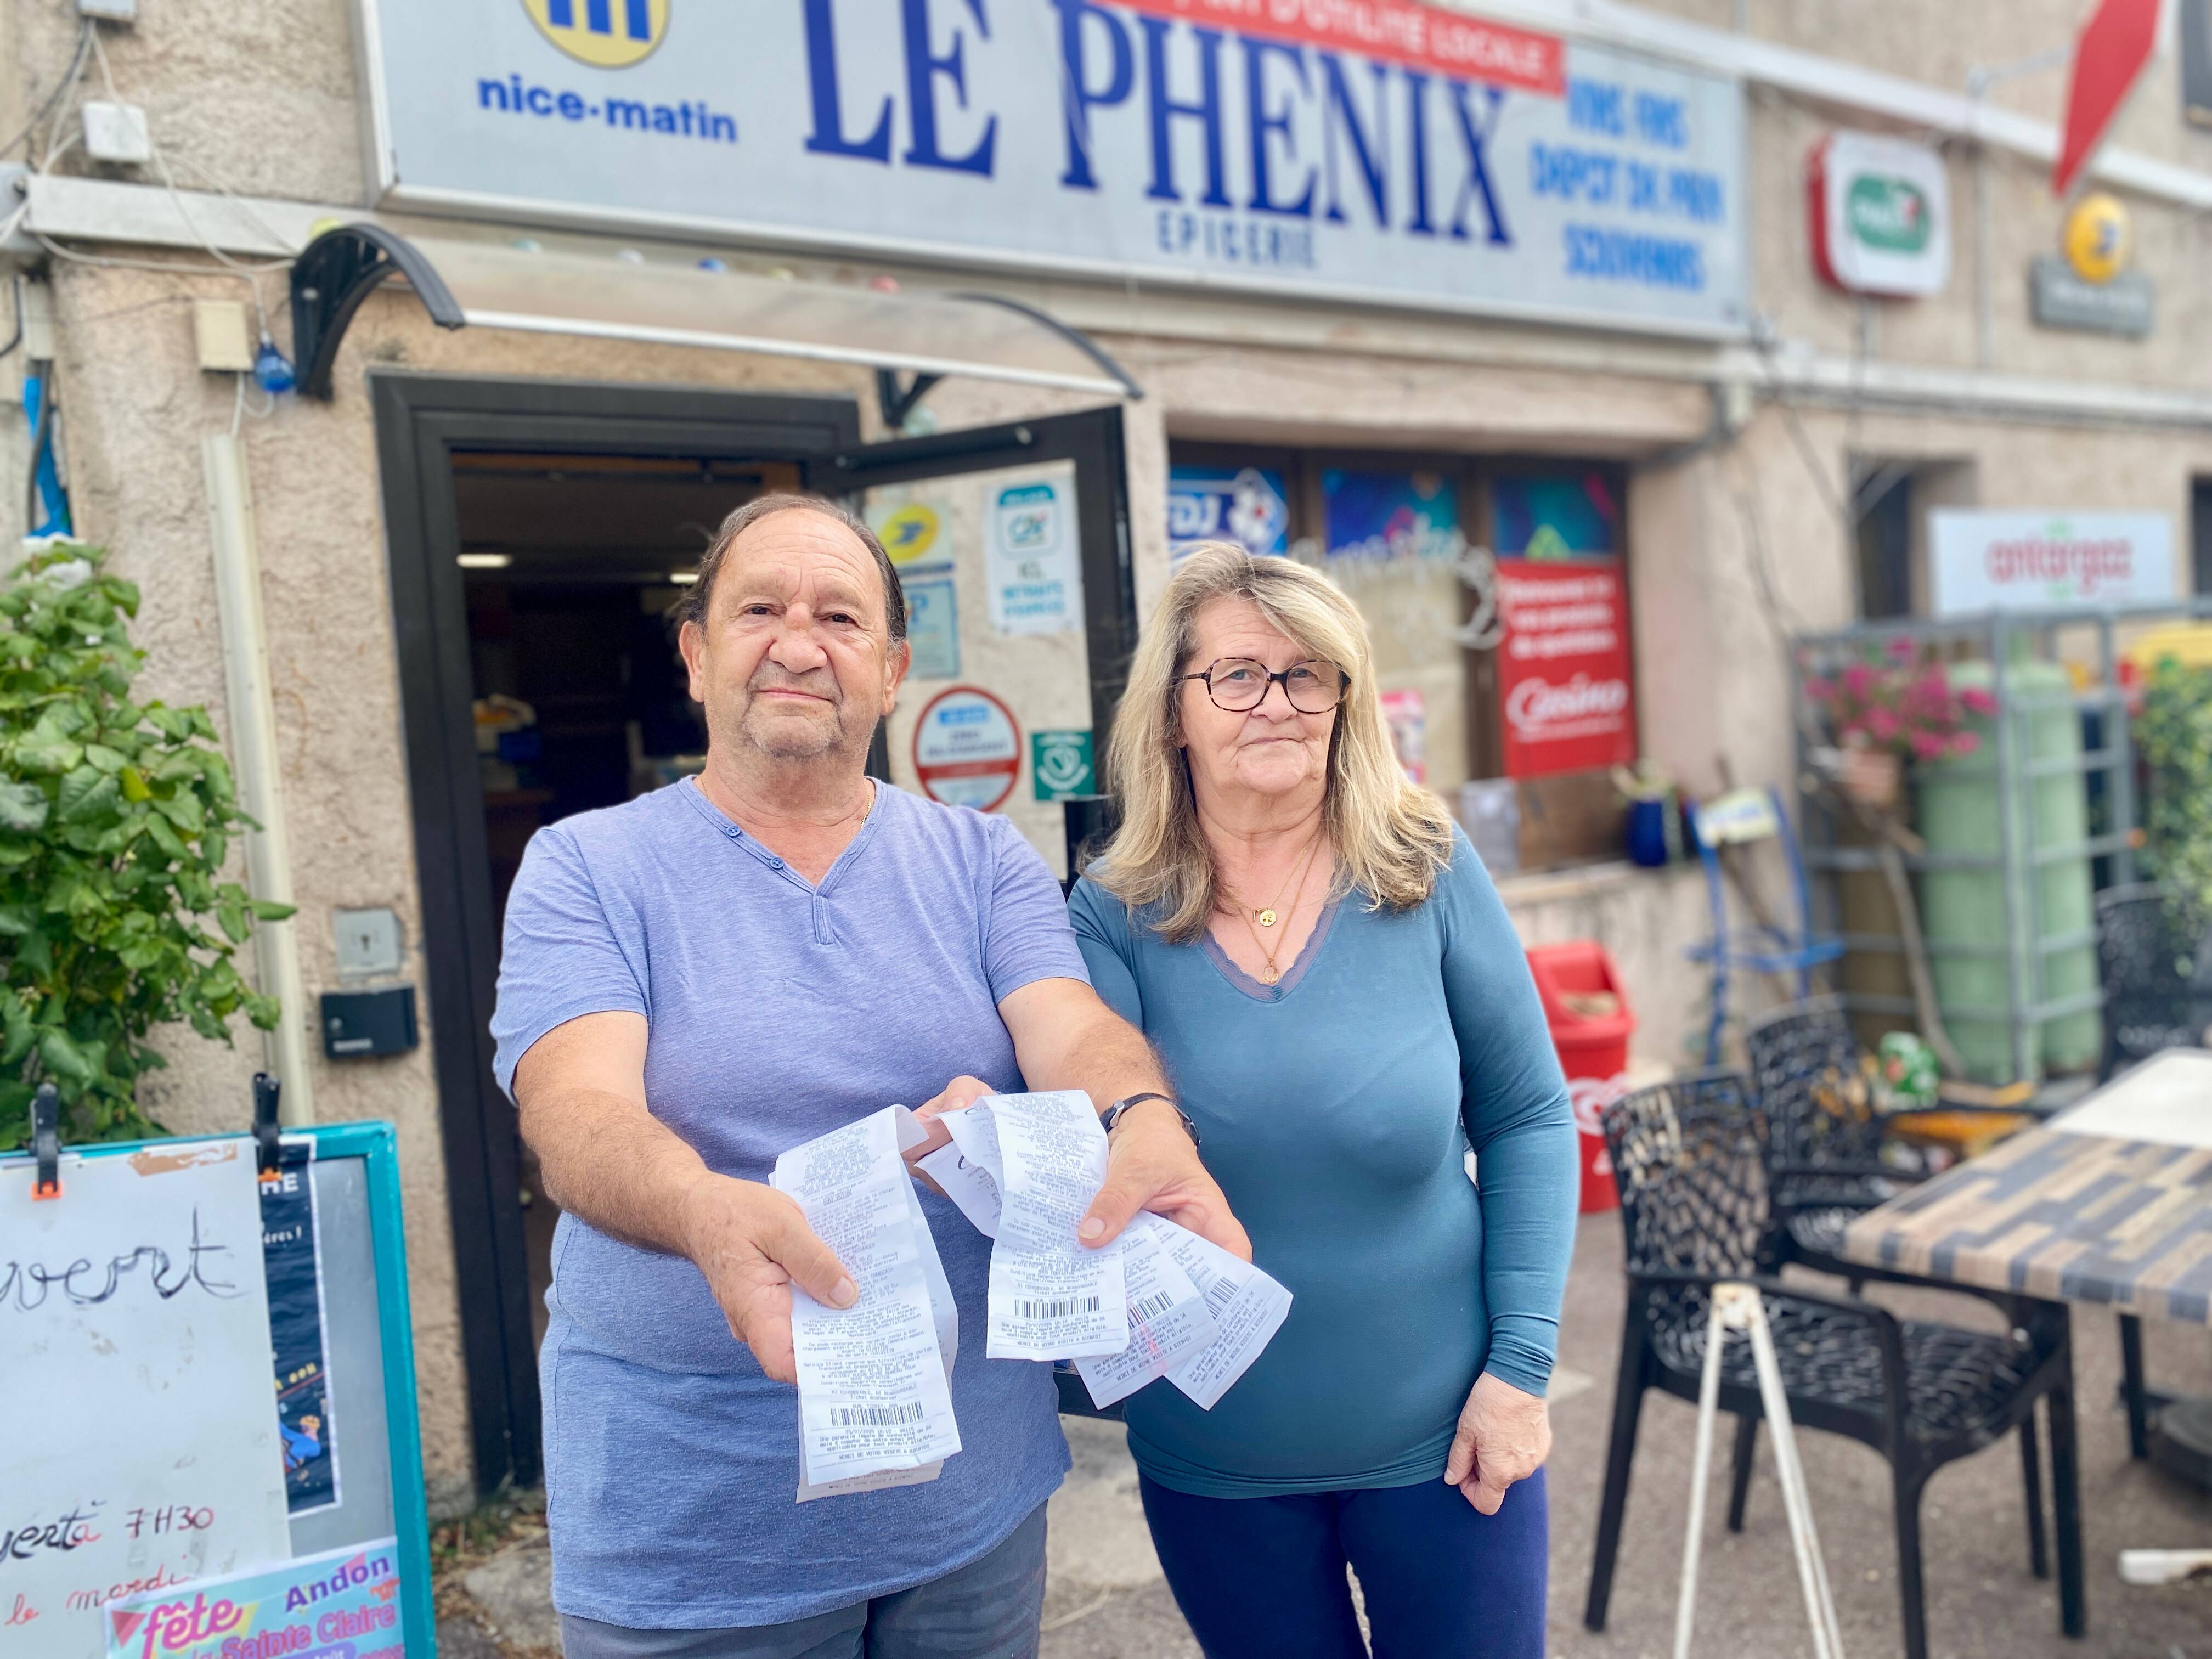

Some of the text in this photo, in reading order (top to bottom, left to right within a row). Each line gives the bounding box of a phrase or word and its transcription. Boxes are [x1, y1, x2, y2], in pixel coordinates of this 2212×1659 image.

[802, 0, 1517, 247] LE PHENIX
[1506, 673, 1628, 732] Casino
[65, 1554, 193, 1611] mardi
[142, 1555, 391, 1659] fête Andon
[221, 1602, 397, 1659] Sainte Claire
